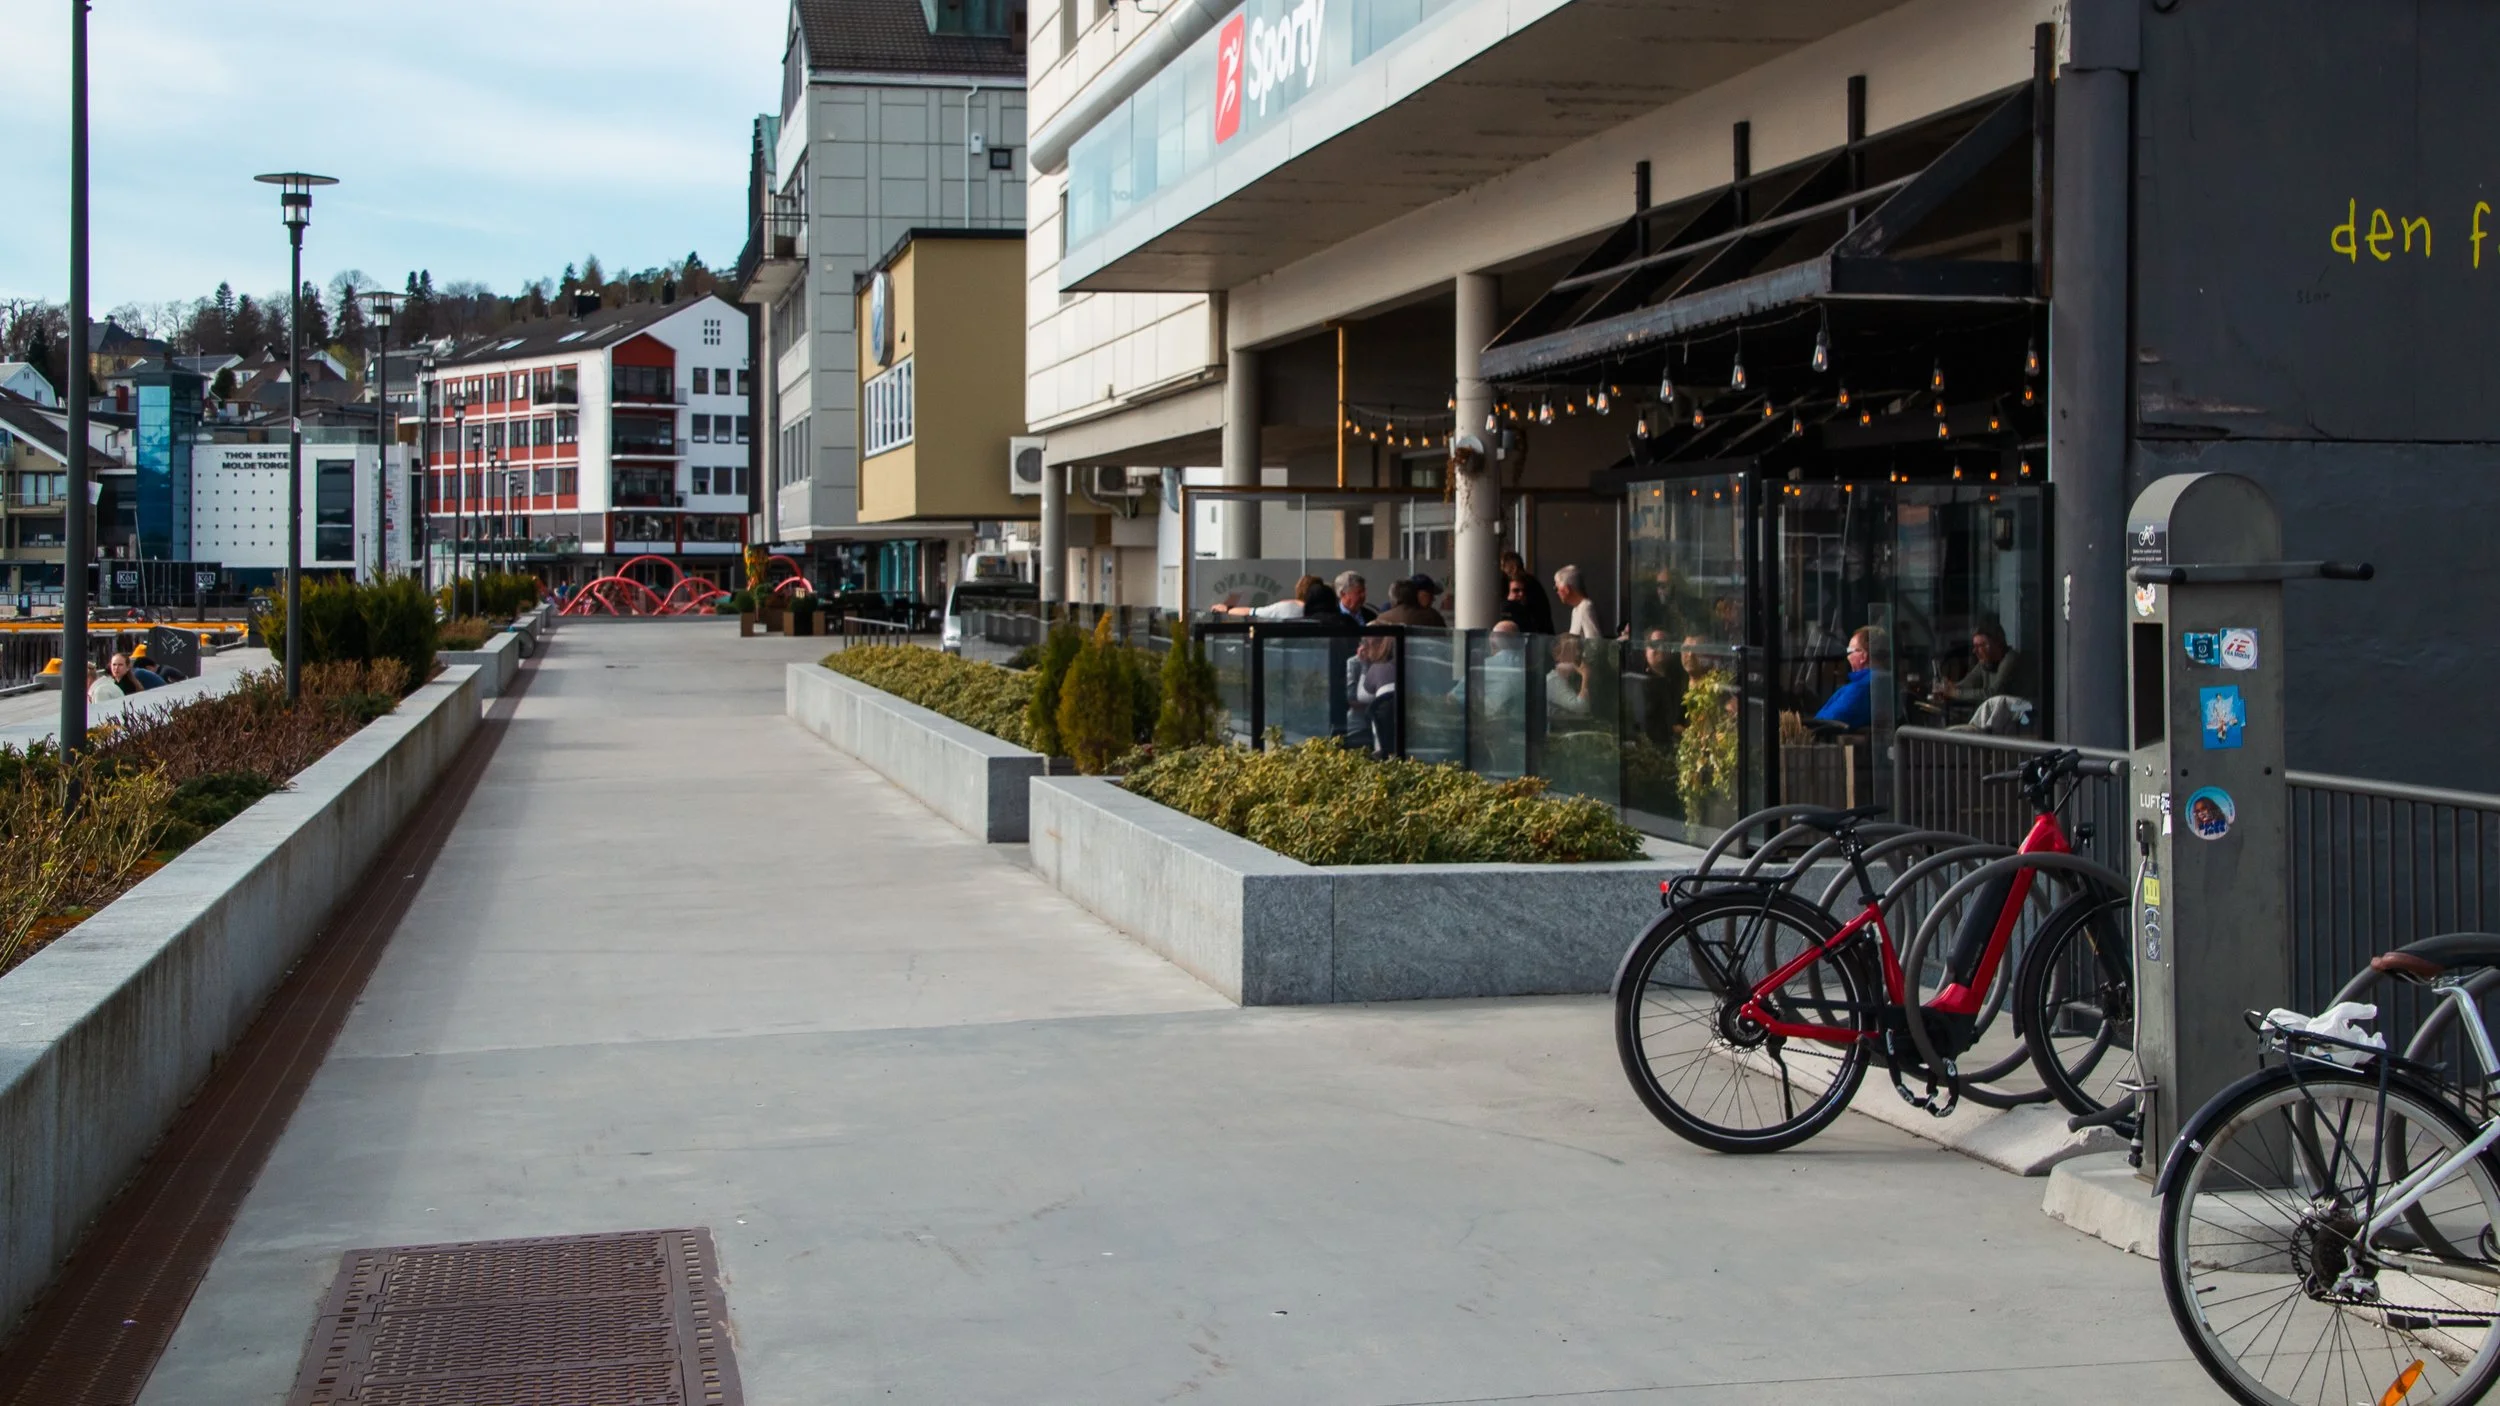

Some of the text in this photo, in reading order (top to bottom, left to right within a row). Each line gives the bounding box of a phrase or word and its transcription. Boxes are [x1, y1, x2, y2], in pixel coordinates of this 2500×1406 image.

[1248, 0, 1326, 118] Sporty
[2330, 197, 2500, 269] den f
[224, 451, 290, 460] THON SENTE
[222, 461, 290, 470] MOLDETORGE
[2140, 792, 2161, 809] LUFT
